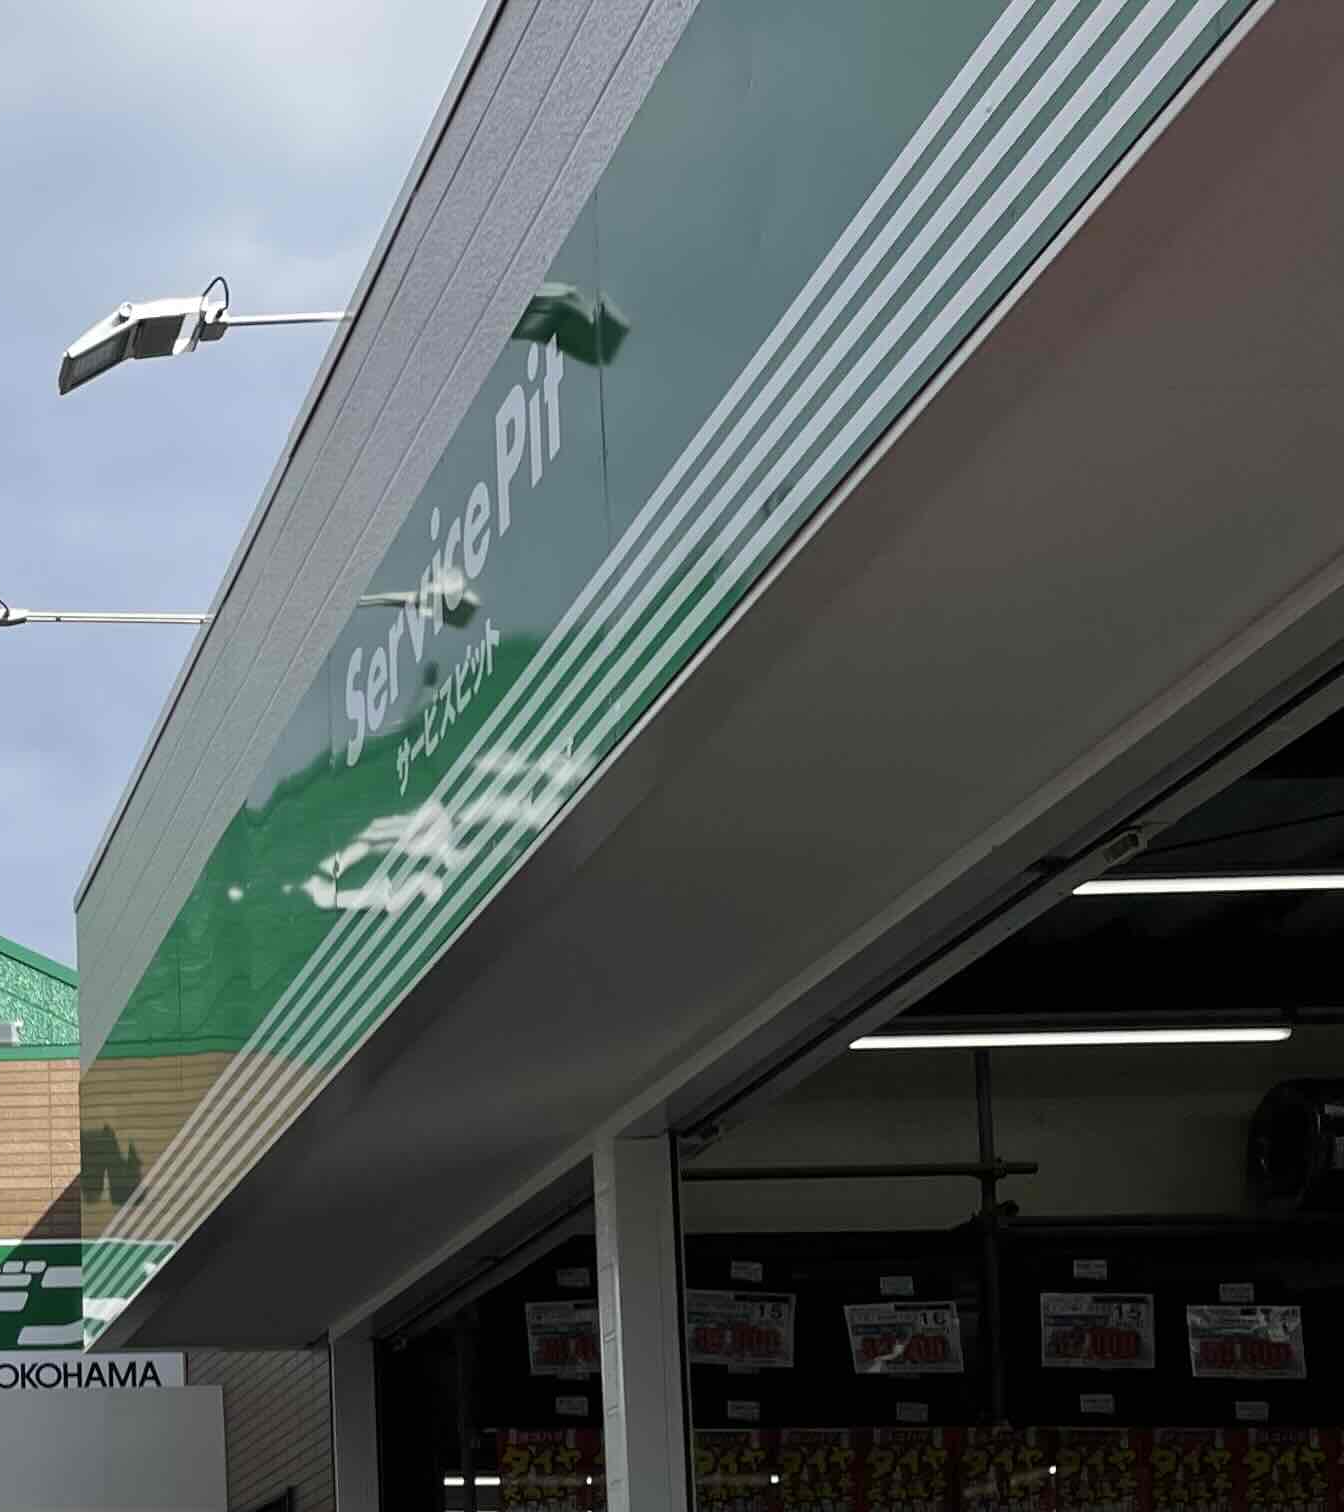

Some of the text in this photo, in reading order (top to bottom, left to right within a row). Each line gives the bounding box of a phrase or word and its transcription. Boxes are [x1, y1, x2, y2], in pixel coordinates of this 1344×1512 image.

[345, 332, 564, 768] Service Pit
[396, 617, 500, 797] サービスピット
